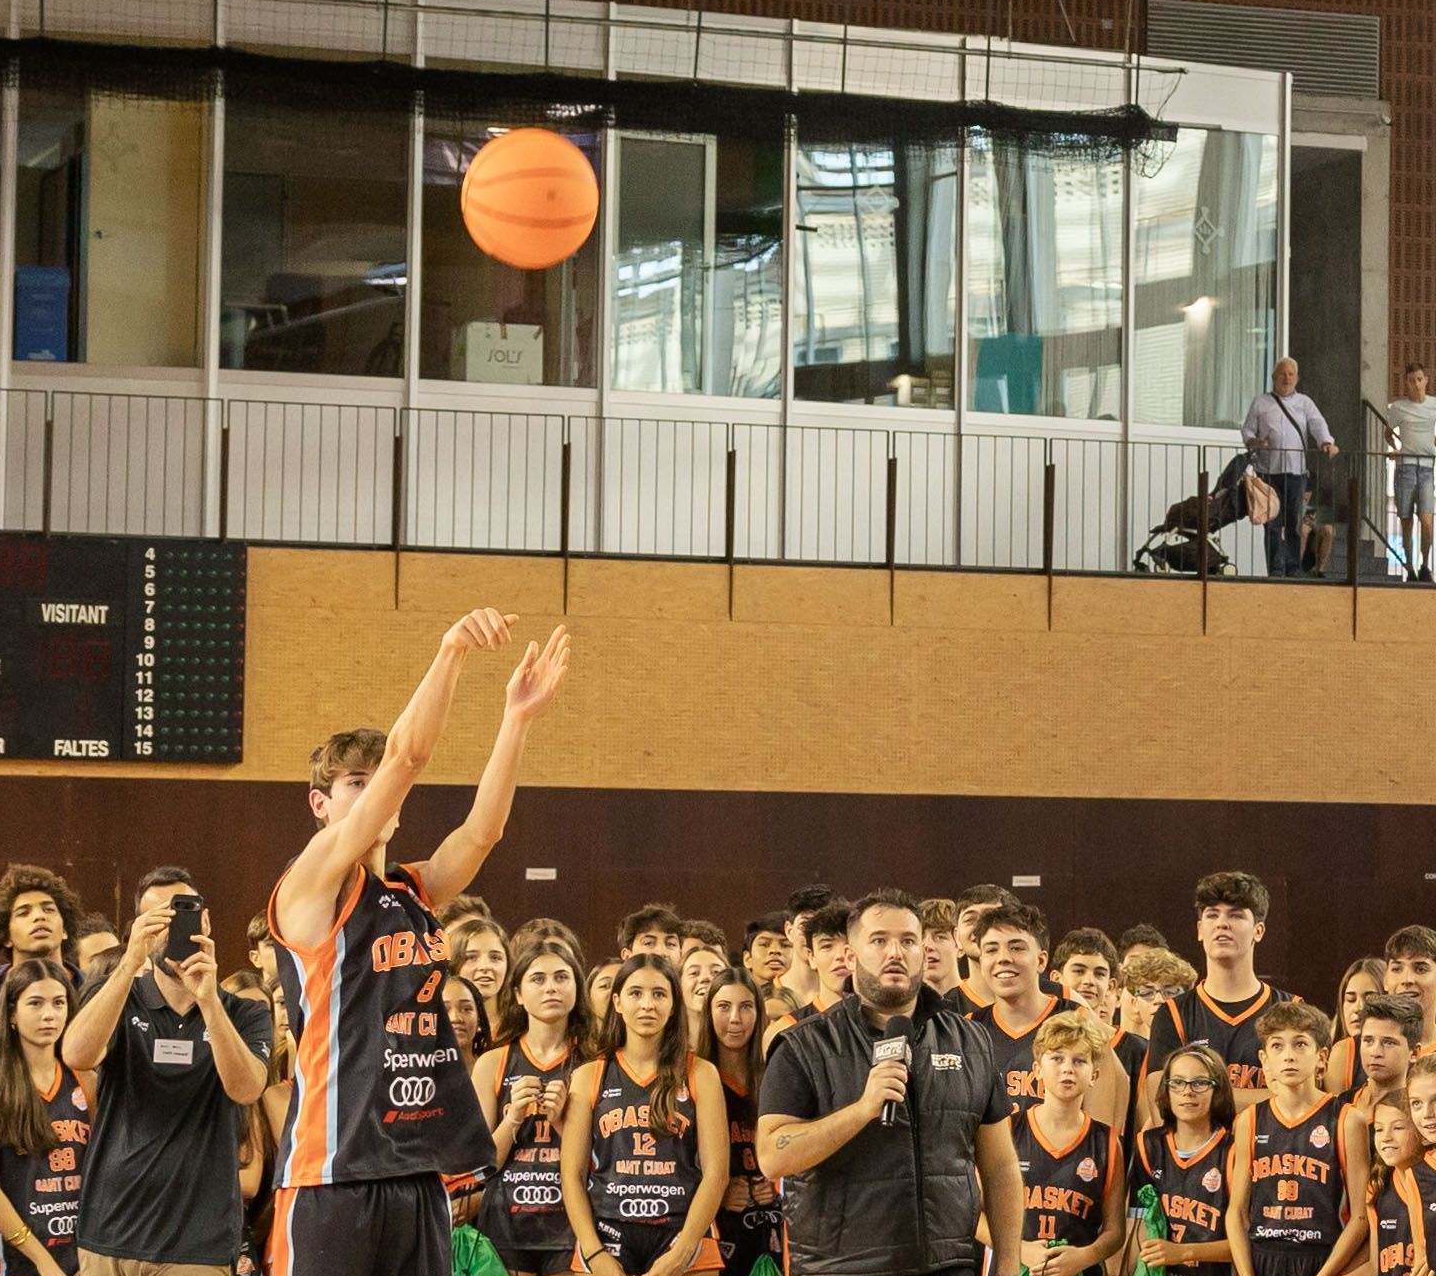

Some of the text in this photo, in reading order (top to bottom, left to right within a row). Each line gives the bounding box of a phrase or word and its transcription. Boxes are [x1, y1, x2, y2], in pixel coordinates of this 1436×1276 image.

[145, 548, 155, 561] 4
[145, 565, 155, 579] 5
[145, 583, 155, 597] 6
[41, 603, 109, 625] VISITANT
[144, 601, 155, 614] 7
[144, 618, 155, 632] 8
[144, 636, 155, 650] 9
[136, 654, 155, 668] 10
[136, 672, 154, 685] 11
[135, 689, 154, 703] 12
[135, 707, 154, 721] 13
[135, 724, 154, 738] 14
[54, 739, 109, 757] FALTES
[134, 742, 153, 756] 15
[416, 970, 442, 1004] 8
[632, 1131, 657, 1156] 12
[48, 1147, 76, 1172] 88
[605, 1182, 686, 1197] Superwagen
[1037, 1216, 1056, 1239] 11
